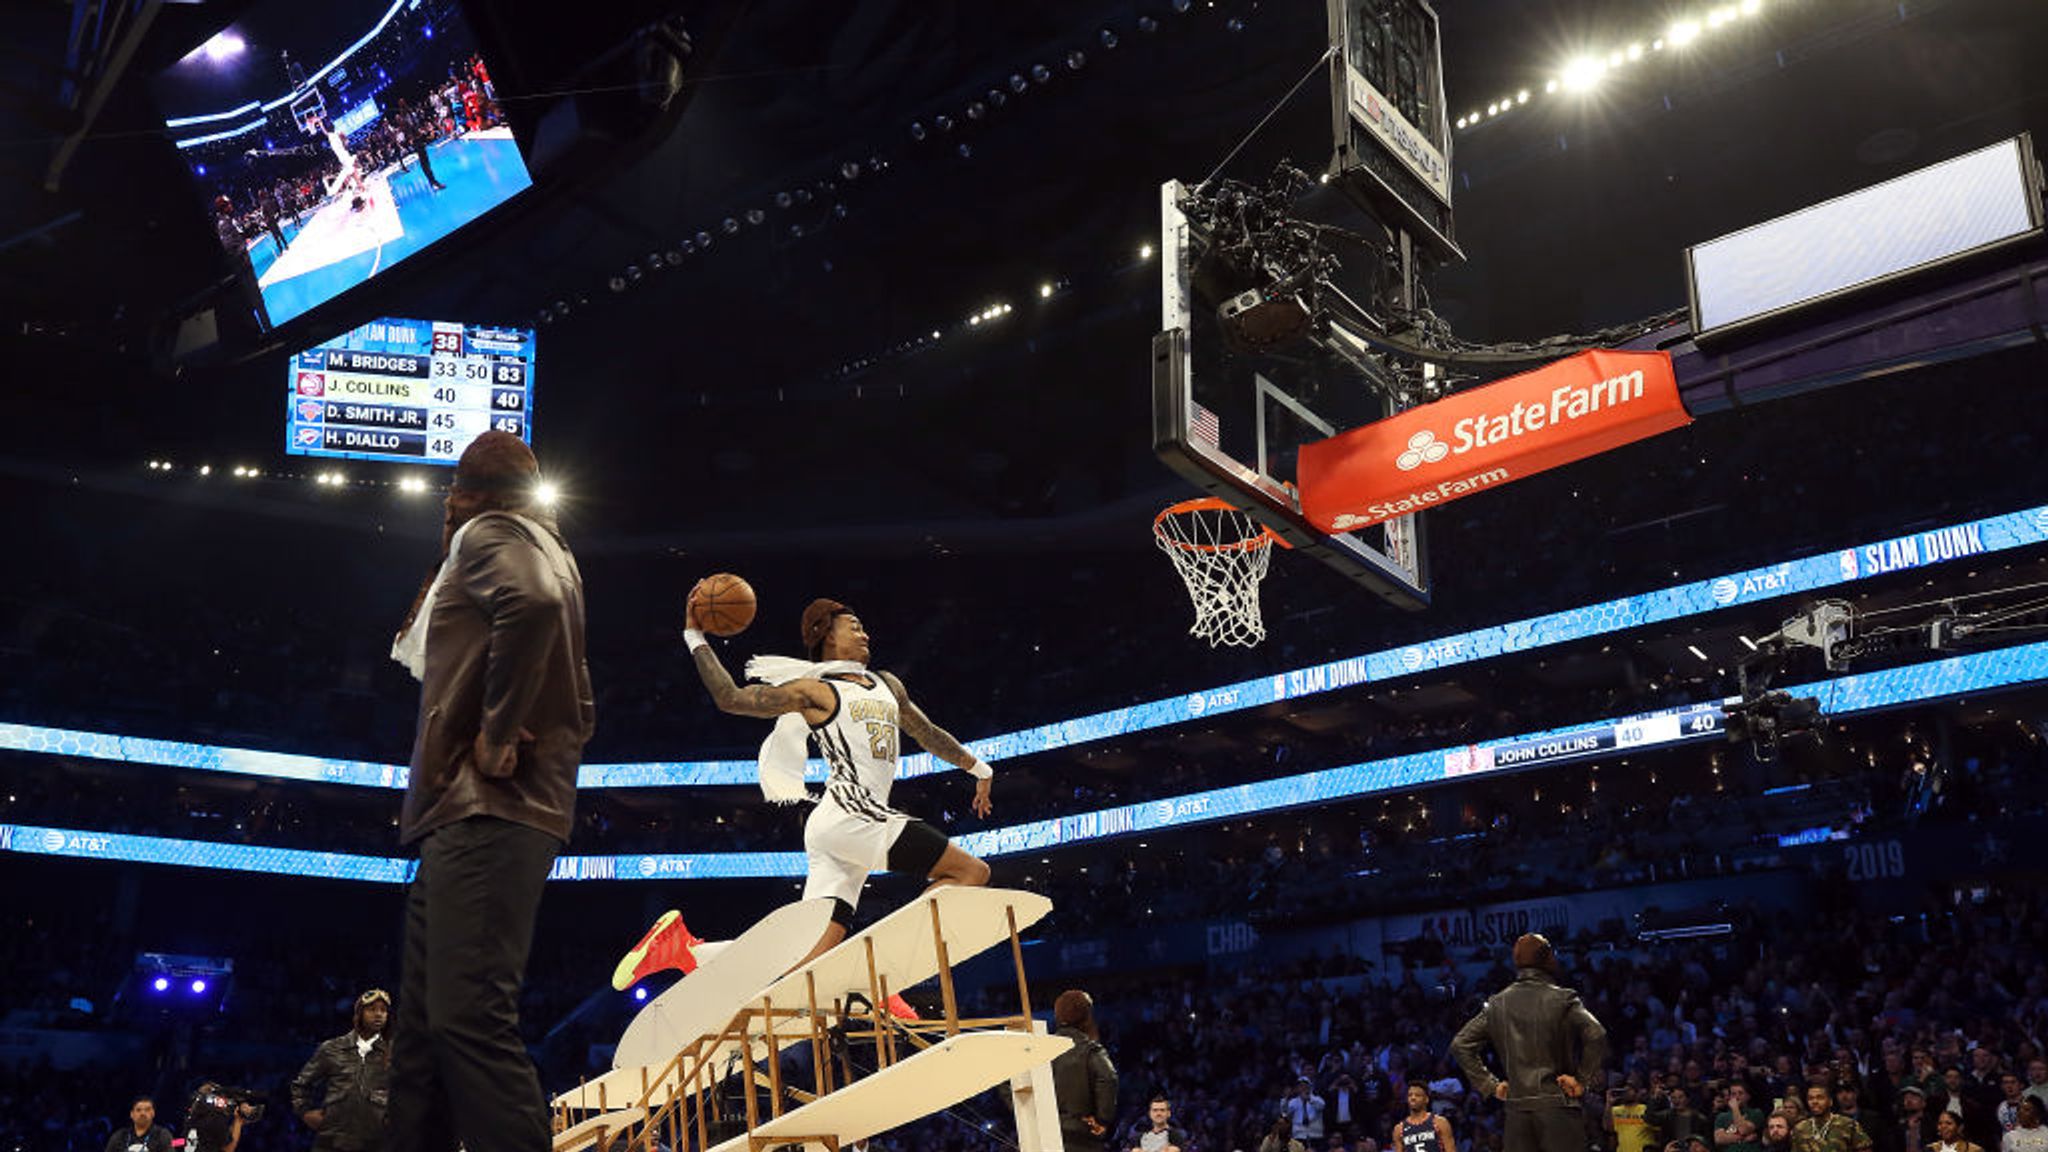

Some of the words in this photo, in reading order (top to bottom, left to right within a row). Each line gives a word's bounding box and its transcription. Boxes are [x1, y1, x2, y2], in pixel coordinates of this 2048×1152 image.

[388, 326, 417, 343] DUNK
[436, 333, 458, 350] 38
[329, 353, 348, 367] M.
[352, 355, 418, 372] BRIDGES
[435, 362, 457, 378] 33
[466, 364, 488, 380] 50
[498, 367, 520, 383] 83
[328, 381, 342, 393] J.
[346, 381, 410, 397] COLLINS
[434, 387, 456, 403] 40
[497, 393, 519, 408] 40
[327, 406, 341, 419] D.
[345, 407, 395, 423] SMITH
[398, 411, 422, 425] JR.
[432, 413, 455, 429] 45
[496, 417, 518, 433] 45
[326, 432, 341, 446] H.
[346, 433, 400, 448] DIALLO
[432, 438, 454, 454] 48
[1866, 536, 1919, 575] SLAM
[1924, 522, 1984, 563] DUNK
[1742, 570, 1790, 596] AT&T
[1426, 642, 1465, 662] AT&T
[1292, 667, 1326, 696] SLAM
[1330, 656, 1367, 689] DUNK
[1208, 690, 1240, 710] AT&T
[1498, 747, 1536, 764] JOHN
[1538, 735, 1598, 757] COLLINS
[1621, 726, 1644, 743] 40
[1690, 713, 1715, 731] 40
[903, 752, 934, 778] DUNK
[1177, 798, 1211, 816] AT&T
[1068, 811, 1098, 840] SLAM
[1102, 806, 1134, 833] DUNK
[68, 834, 110, 851] AT&T
[548, 856, 578, 880] LAM
[581, 855, 617, 880] DUNK
[660, 859, 693, 873] AT&T
[1844, 839, 1905, 881] 2019
[1414, 1142, 1426, 1152] 5
